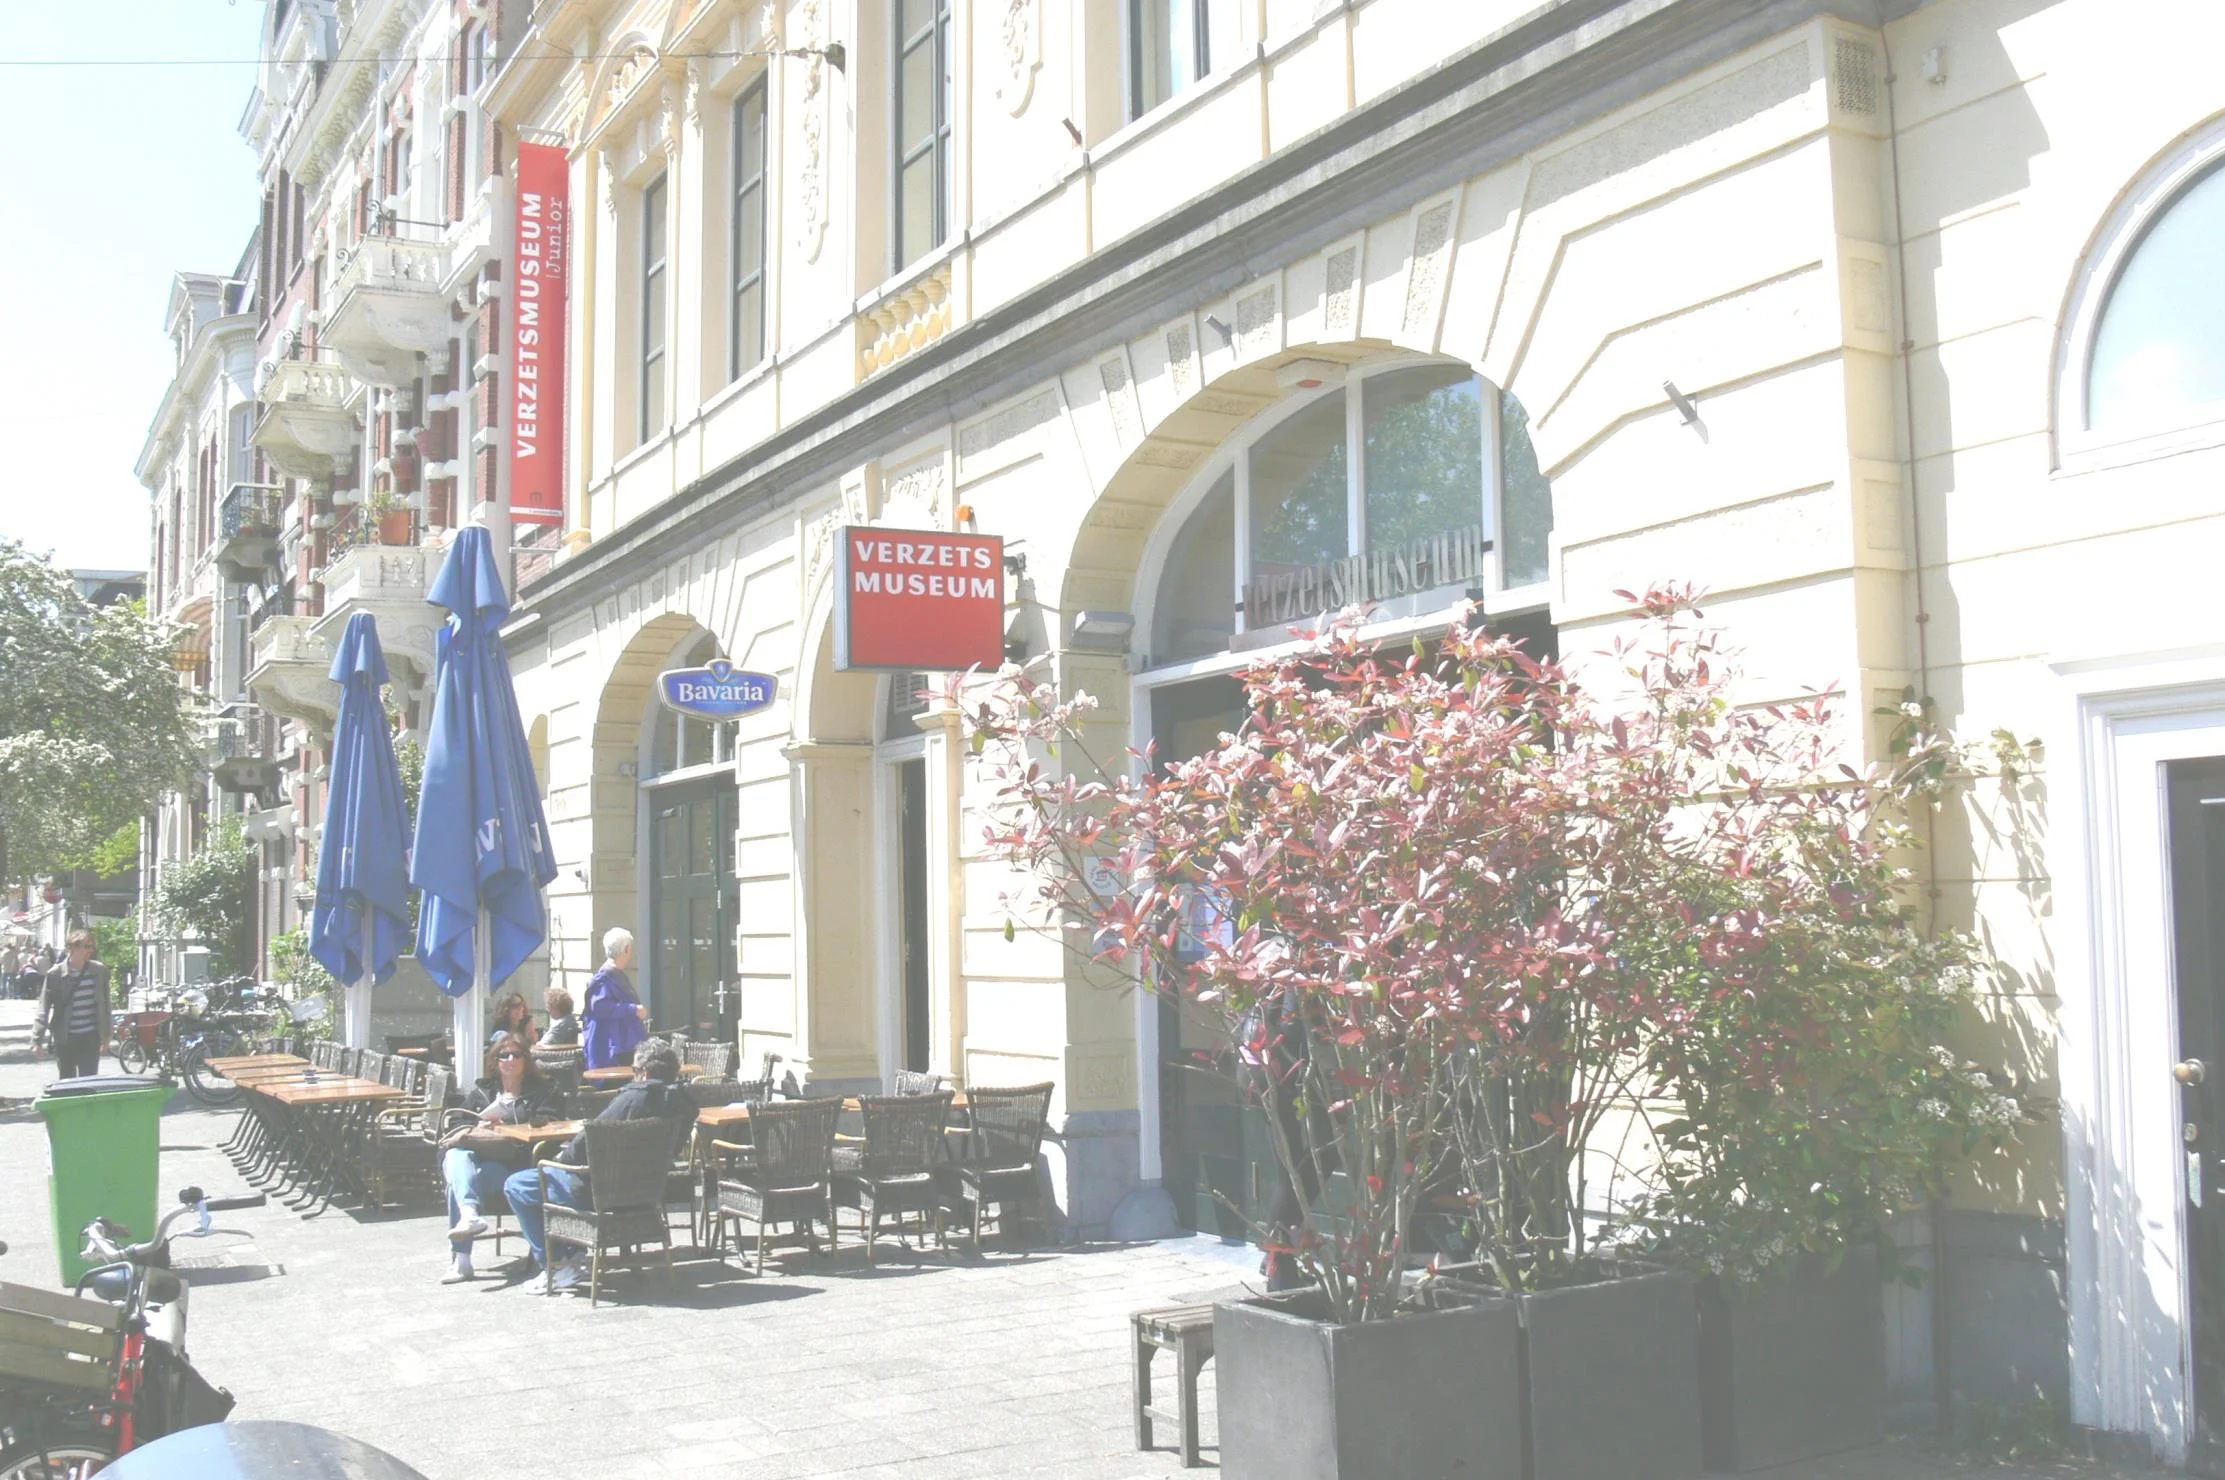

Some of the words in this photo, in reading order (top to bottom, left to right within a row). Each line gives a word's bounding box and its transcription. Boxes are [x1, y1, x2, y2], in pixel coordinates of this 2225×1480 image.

[515, 193, 541, 458] VERZETSMUSEUM
[855, 540, 992, 569] VERZETS
[855, 571, 995, 599] MUSEUM
[678, 682, 763, 702] Bavaria
